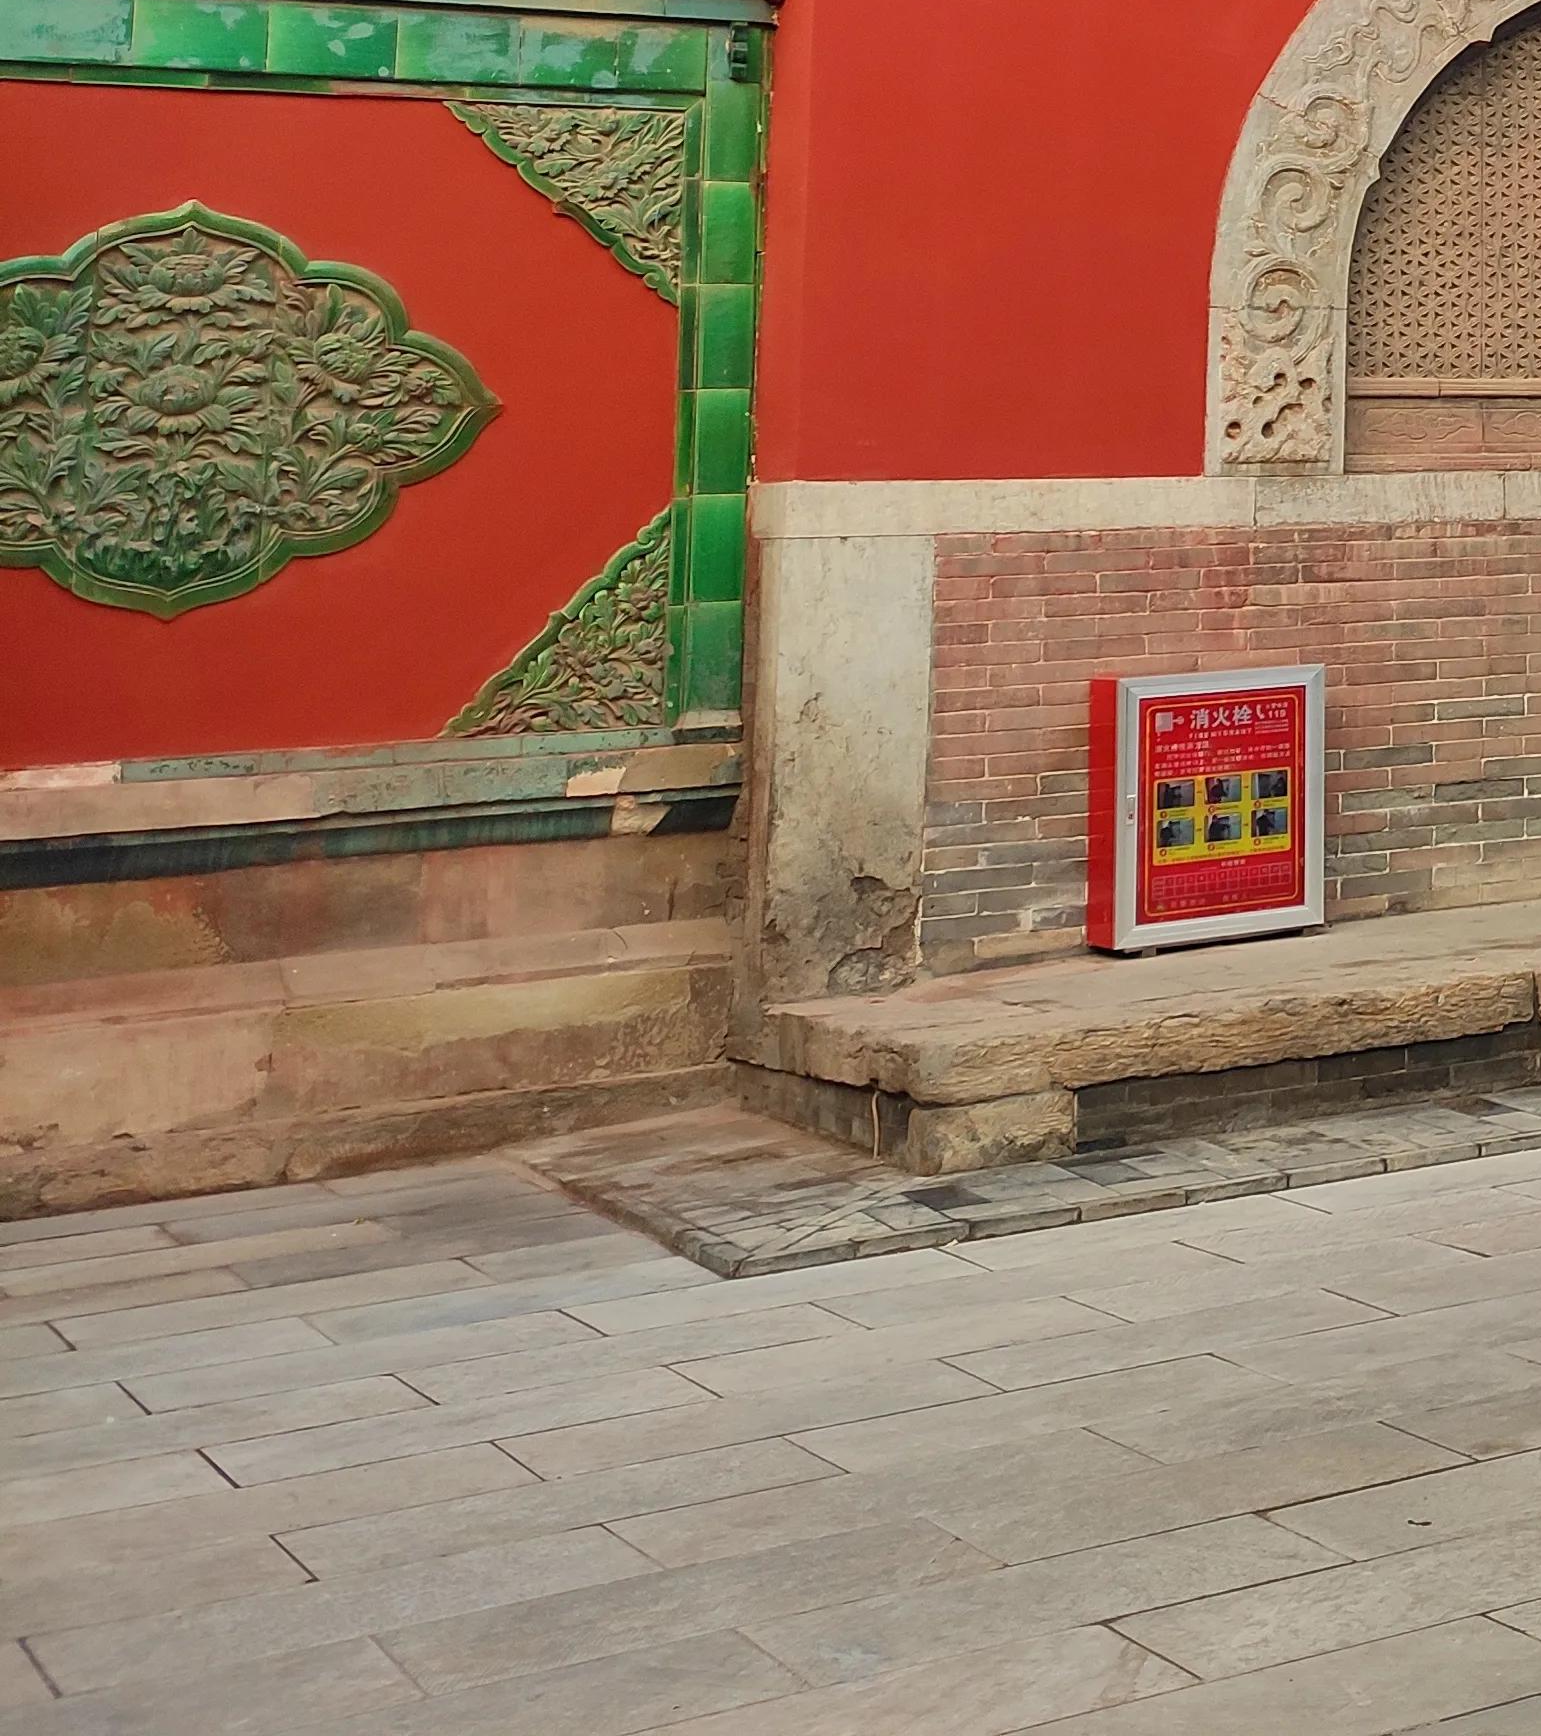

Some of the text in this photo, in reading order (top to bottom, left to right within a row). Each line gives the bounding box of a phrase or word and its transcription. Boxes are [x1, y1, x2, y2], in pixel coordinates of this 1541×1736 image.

[1190, 704, 1253, 730] 消火栓
[1268, 710, 1287, 719] 119
